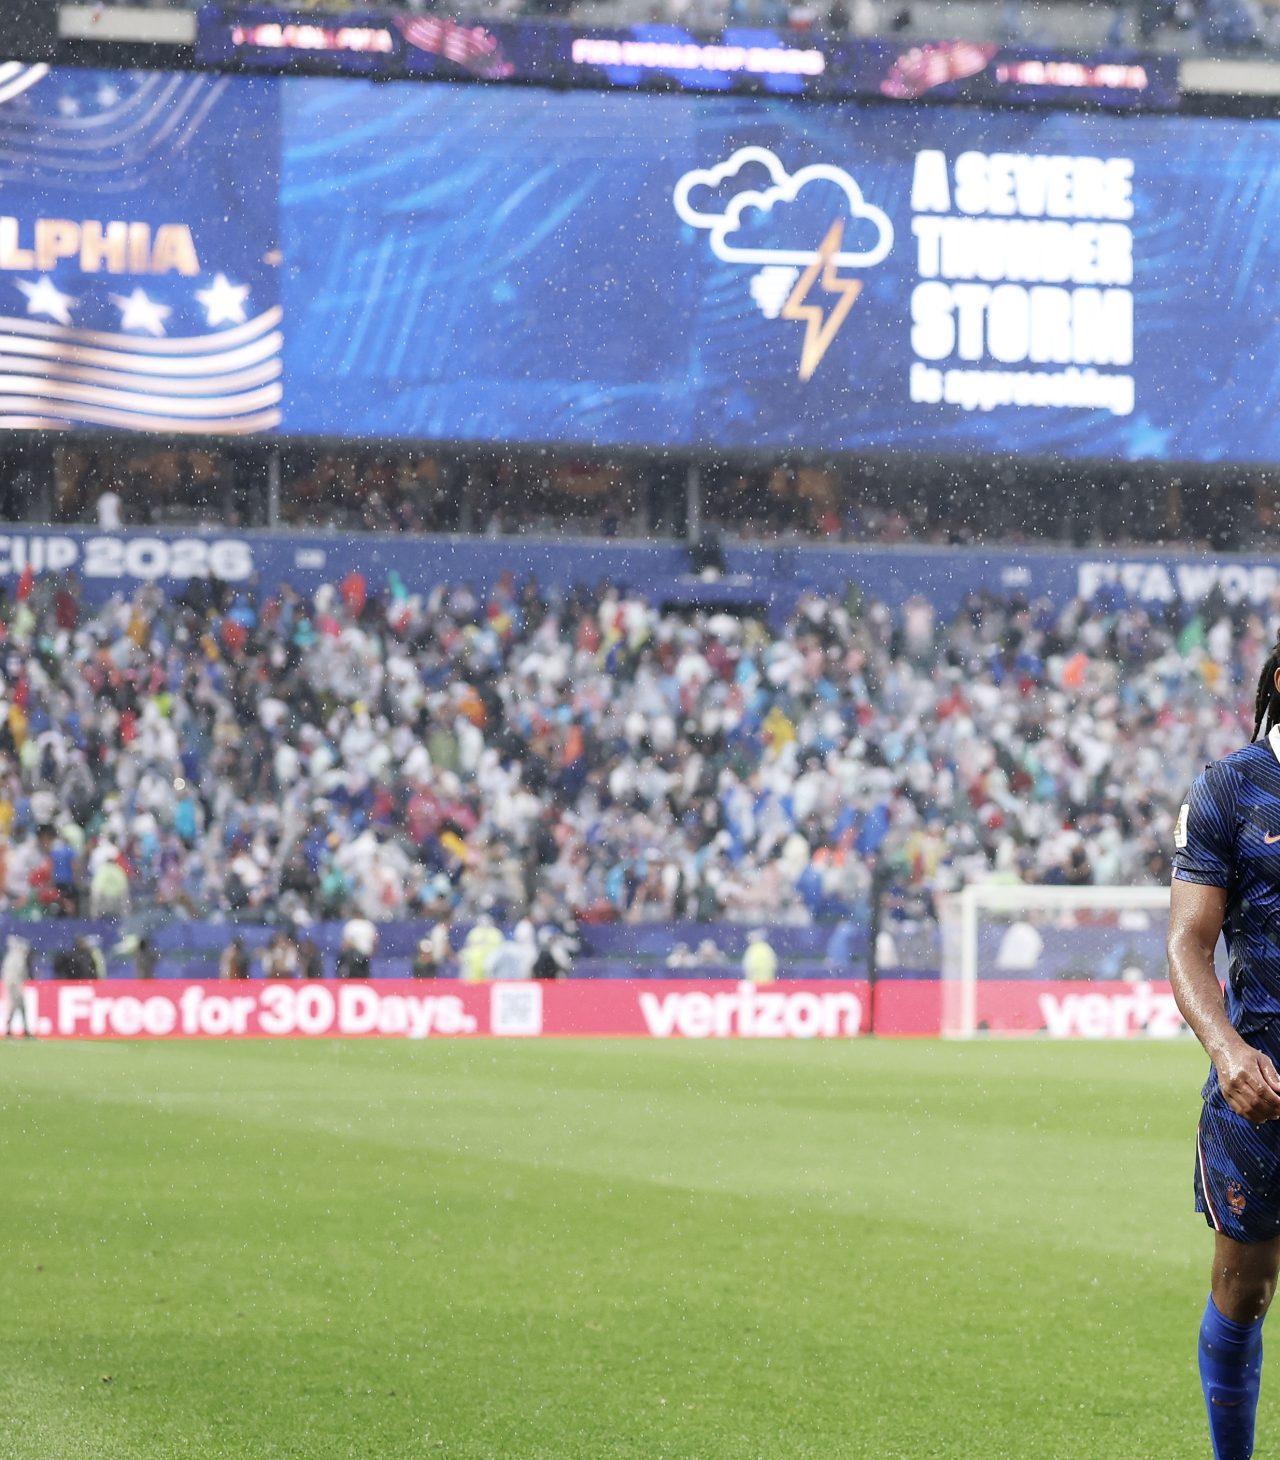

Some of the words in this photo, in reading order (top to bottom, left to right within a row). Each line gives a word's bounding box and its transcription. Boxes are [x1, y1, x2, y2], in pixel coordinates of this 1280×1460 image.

[911, 150, 950, 213] A
[954, 151, 1134, 220] SEVERE
[911, 284, 1134, 365] STORM
[84, 539, 253, 580] 2026
[58, 987, 177, 1034] Free
[182, 985, 257, 1034] for
[259, 985, 335, 1034] 30
[340, 987, 476, 1038] Days.
[639, 982, 861, 1037] verizon
